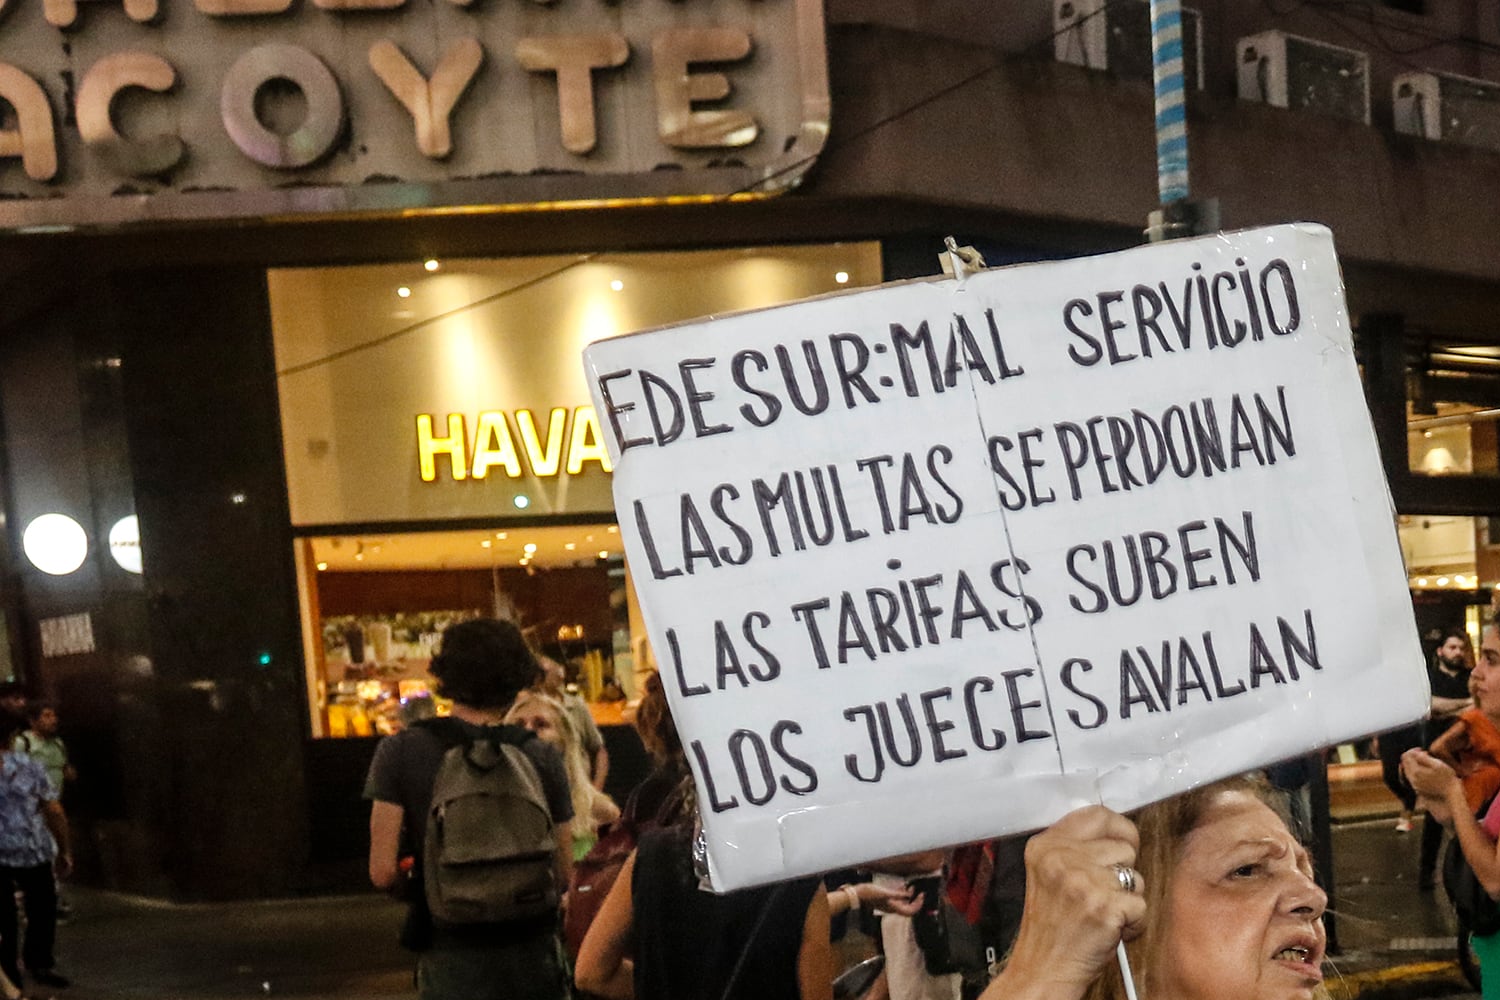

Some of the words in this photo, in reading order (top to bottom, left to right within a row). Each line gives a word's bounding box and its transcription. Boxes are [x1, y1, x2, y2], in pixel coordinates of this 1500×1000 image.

[889, 308, 1026, 398] MAL
[1063, 257, 1301, 367] SERVICIO
[416, 405, 613, 482] HAVA
[665, 610, 782, 697] LAS
[790, 556, 1044, 670] TARIFAS
[1065, 510, 1262, 614] SUBEN
[690, 719, 819, 813] LOS
[1119, 608, 1323, 720] AVALAN
